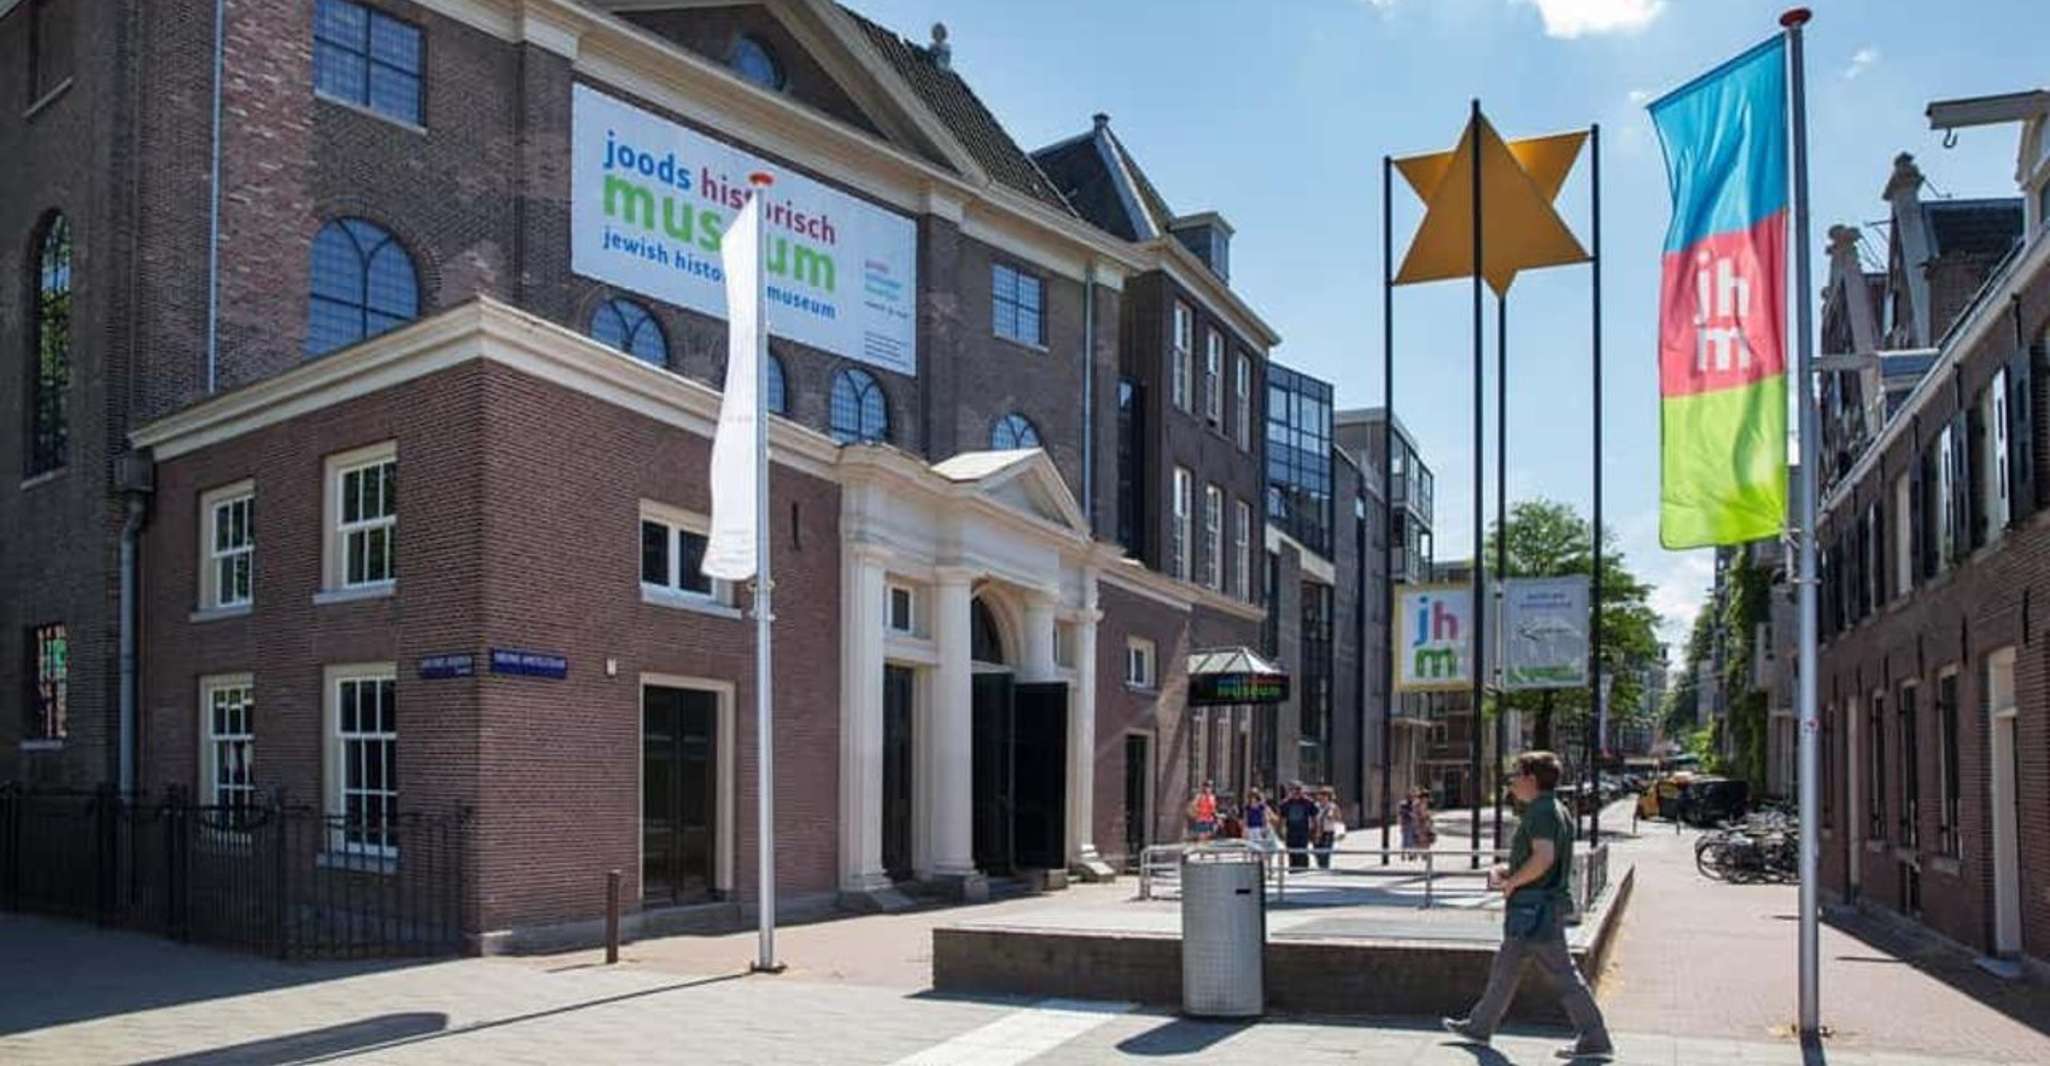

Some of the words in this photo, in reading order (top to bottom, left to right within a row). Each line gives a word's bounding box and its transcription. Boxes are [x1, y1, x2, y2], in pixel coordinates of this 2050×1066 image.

[603, 131, 691, 190] joods
[701, 167, 835, 246] histrisch
[603, 174, 836, 294] musum
[603, 227, 668, 264] jewish
[767, 285, 836, 320] museum
[1693, 249, 1750, 326] jh
[1697, 326, 1751, 373] m
[1413, 596, 1459, 647] jh
[1414, 648, 1459, 678] m
